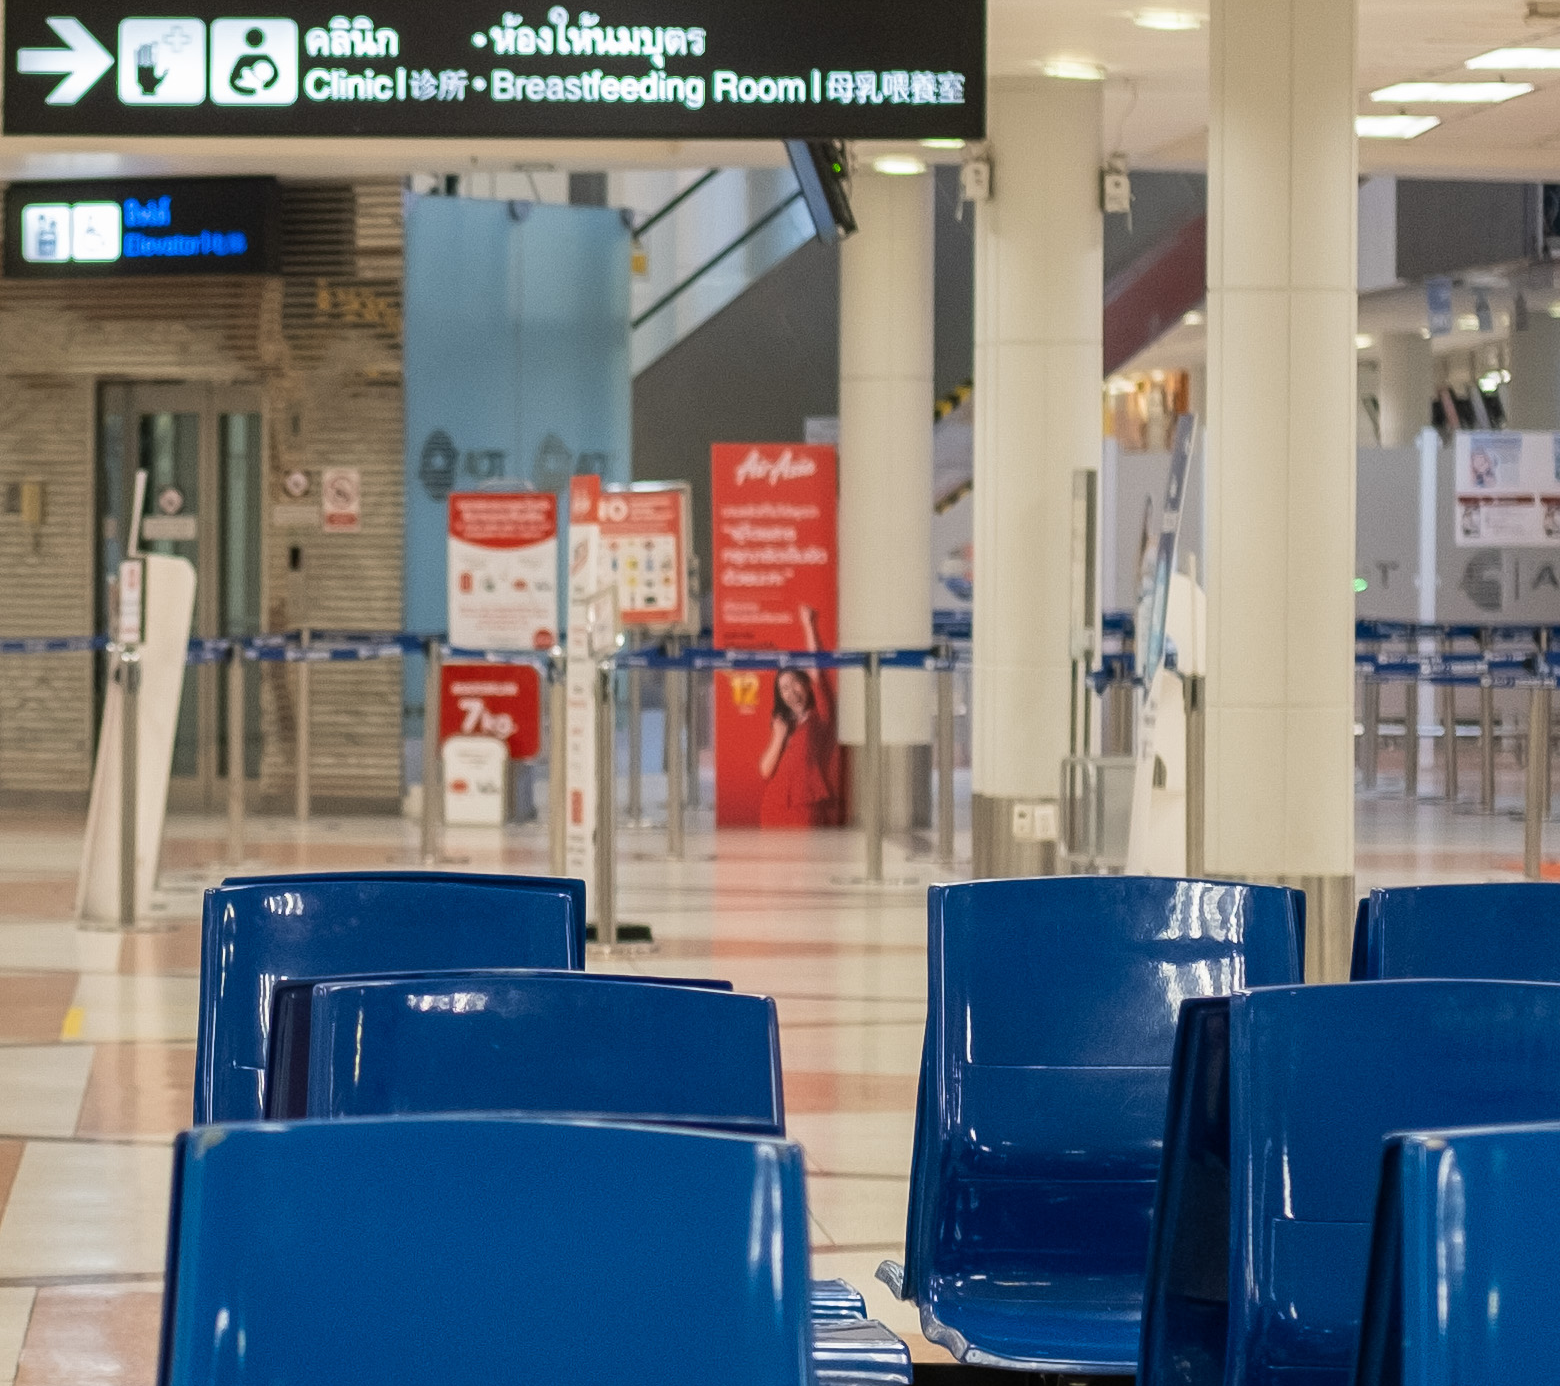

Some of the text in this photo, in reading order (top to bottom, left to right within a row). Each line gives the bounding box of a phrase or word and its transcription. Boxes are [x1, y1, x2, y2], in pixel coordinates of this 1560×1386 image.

[304, 5, 706, 69] คลินิก ห้องให้นมบุตร
[304, 67, 394, 101] Clinic
[491, 68, 705, 110] Breastfeeding
[713, 69, 806, 103] Room
